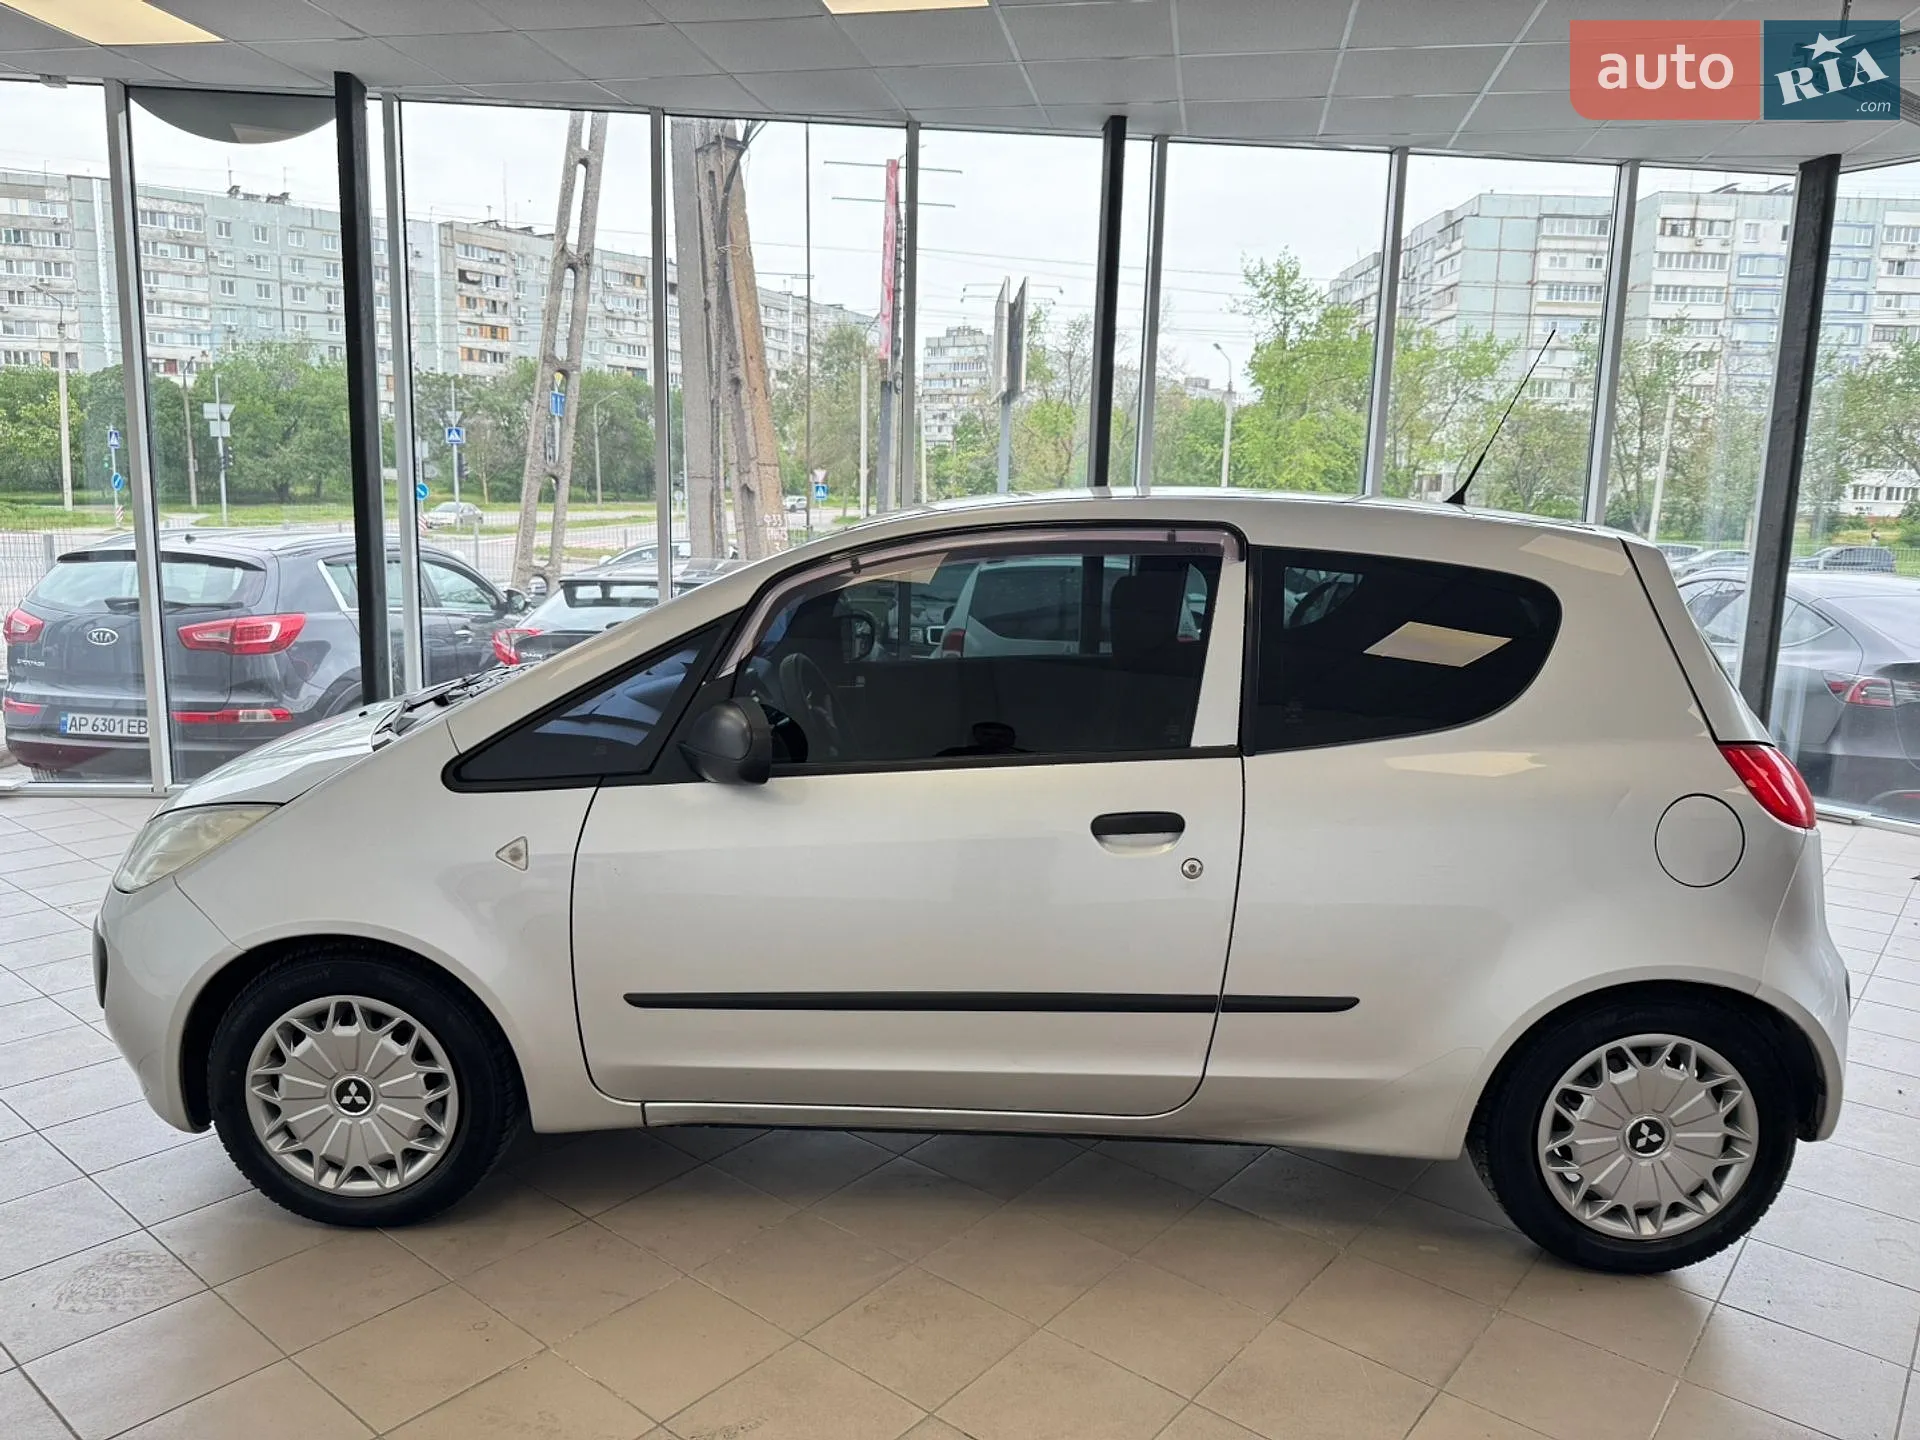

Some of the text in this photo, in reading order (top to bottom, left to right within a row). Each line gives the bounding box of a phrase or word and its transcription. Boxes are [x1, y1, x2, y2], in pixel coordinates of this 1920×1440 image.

[91, 631, 113, 642] KIA
[68, 716, 89, 733] AP
[91, 718, 125, 734] 6301
[126, 719, 149, 735] EB
